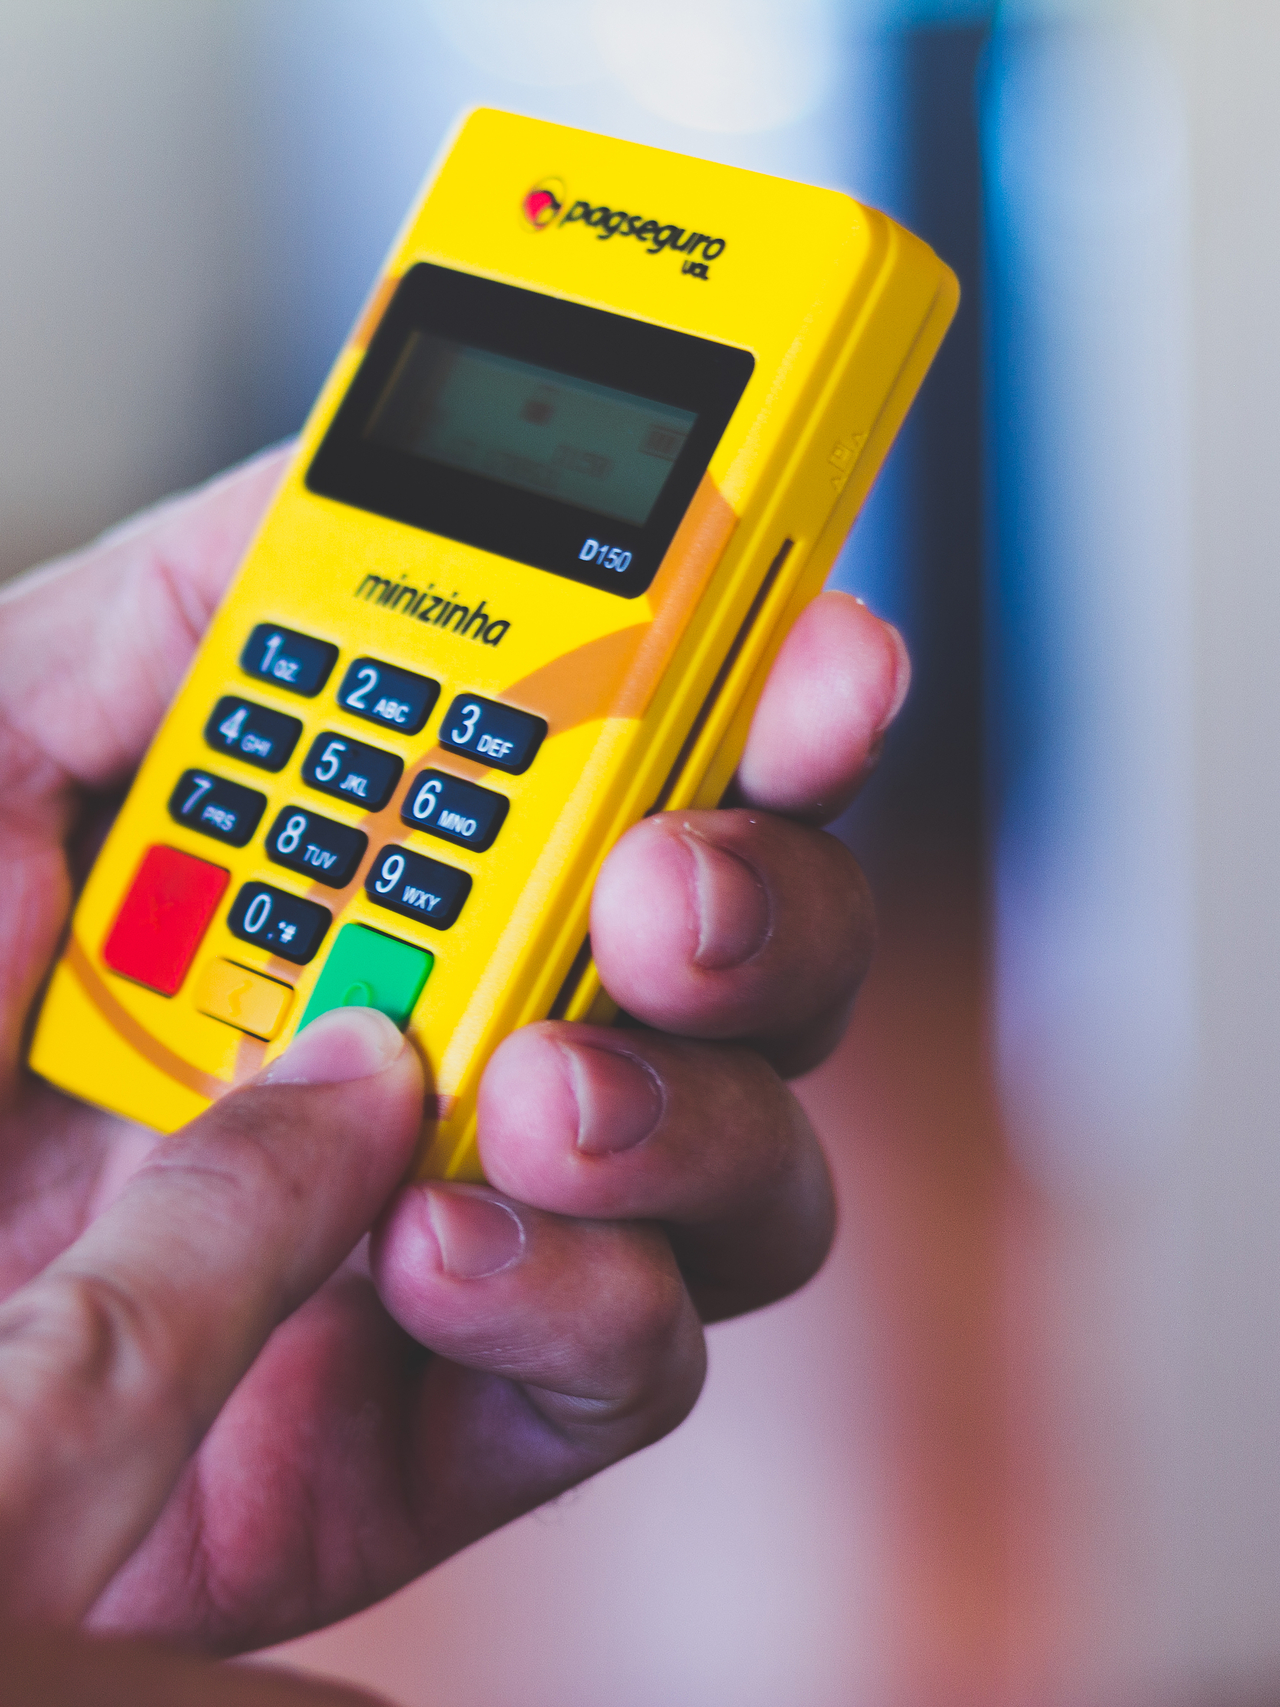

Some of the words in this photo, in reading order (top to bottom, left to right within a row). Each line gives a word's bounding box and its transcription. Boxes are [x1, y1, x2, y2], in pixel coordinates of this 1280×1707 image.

[559, 200, 726, 261] pagseguro
[578, 539, 633, 573] D150
[354, 573, 511, 647] minizinha
[260, 633, 283, 673] 1
[346, 666, 379, 710] 2
[372, 698, 410, 723] ABC
[218, 706, 249, 745] 4
[451, 704, 481, 745] 3
[476, 734, 514, 759] DEF
[315, 742, 347, 782] 5
[340, 774, 368, 798] JKL
[181, 777, 211, 814] 7
[201, 806, 237, 832] PRS
[413, 780, 443, 820] 6
[437, 810, 478, 837] MNO
[276, 815, 307, 854] 8
[303, 845, 337, 869] TUV
[374, 854, 405, 894] 9
[403, 885, 441, 912] WXY
[243, 892, 272, 934] 0
